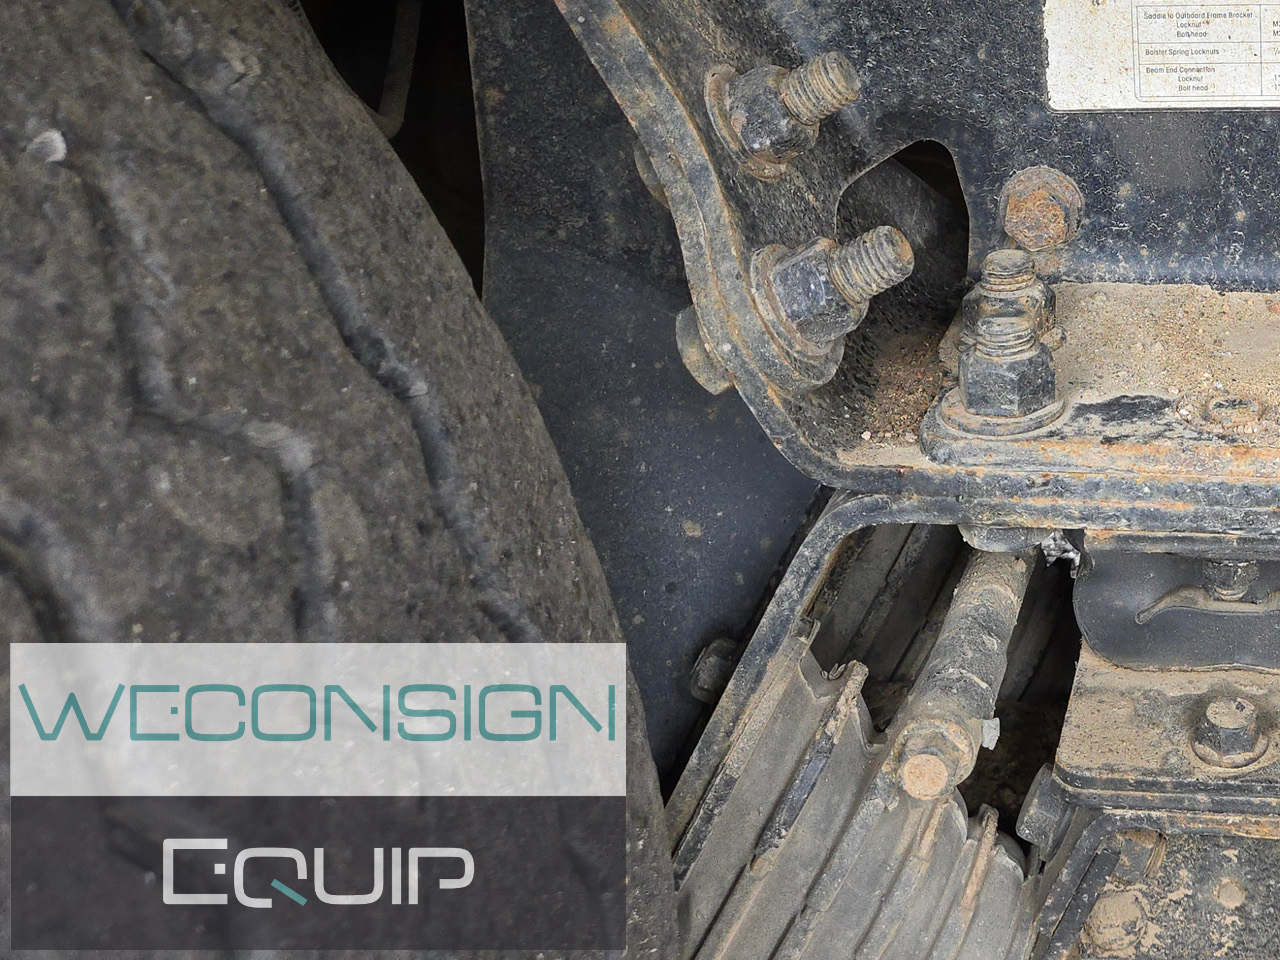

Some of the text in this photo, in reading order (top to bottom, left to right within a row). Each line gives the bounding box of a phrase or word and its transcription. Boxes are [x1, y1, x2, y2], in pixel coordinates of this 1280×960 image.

[1228, 11, 1253, 19] Bracket
[1145, 48, 1167, 56] Bolster
[1168, 48, 1190, 57] Spring
[1166, 66, 1178, 74] End
